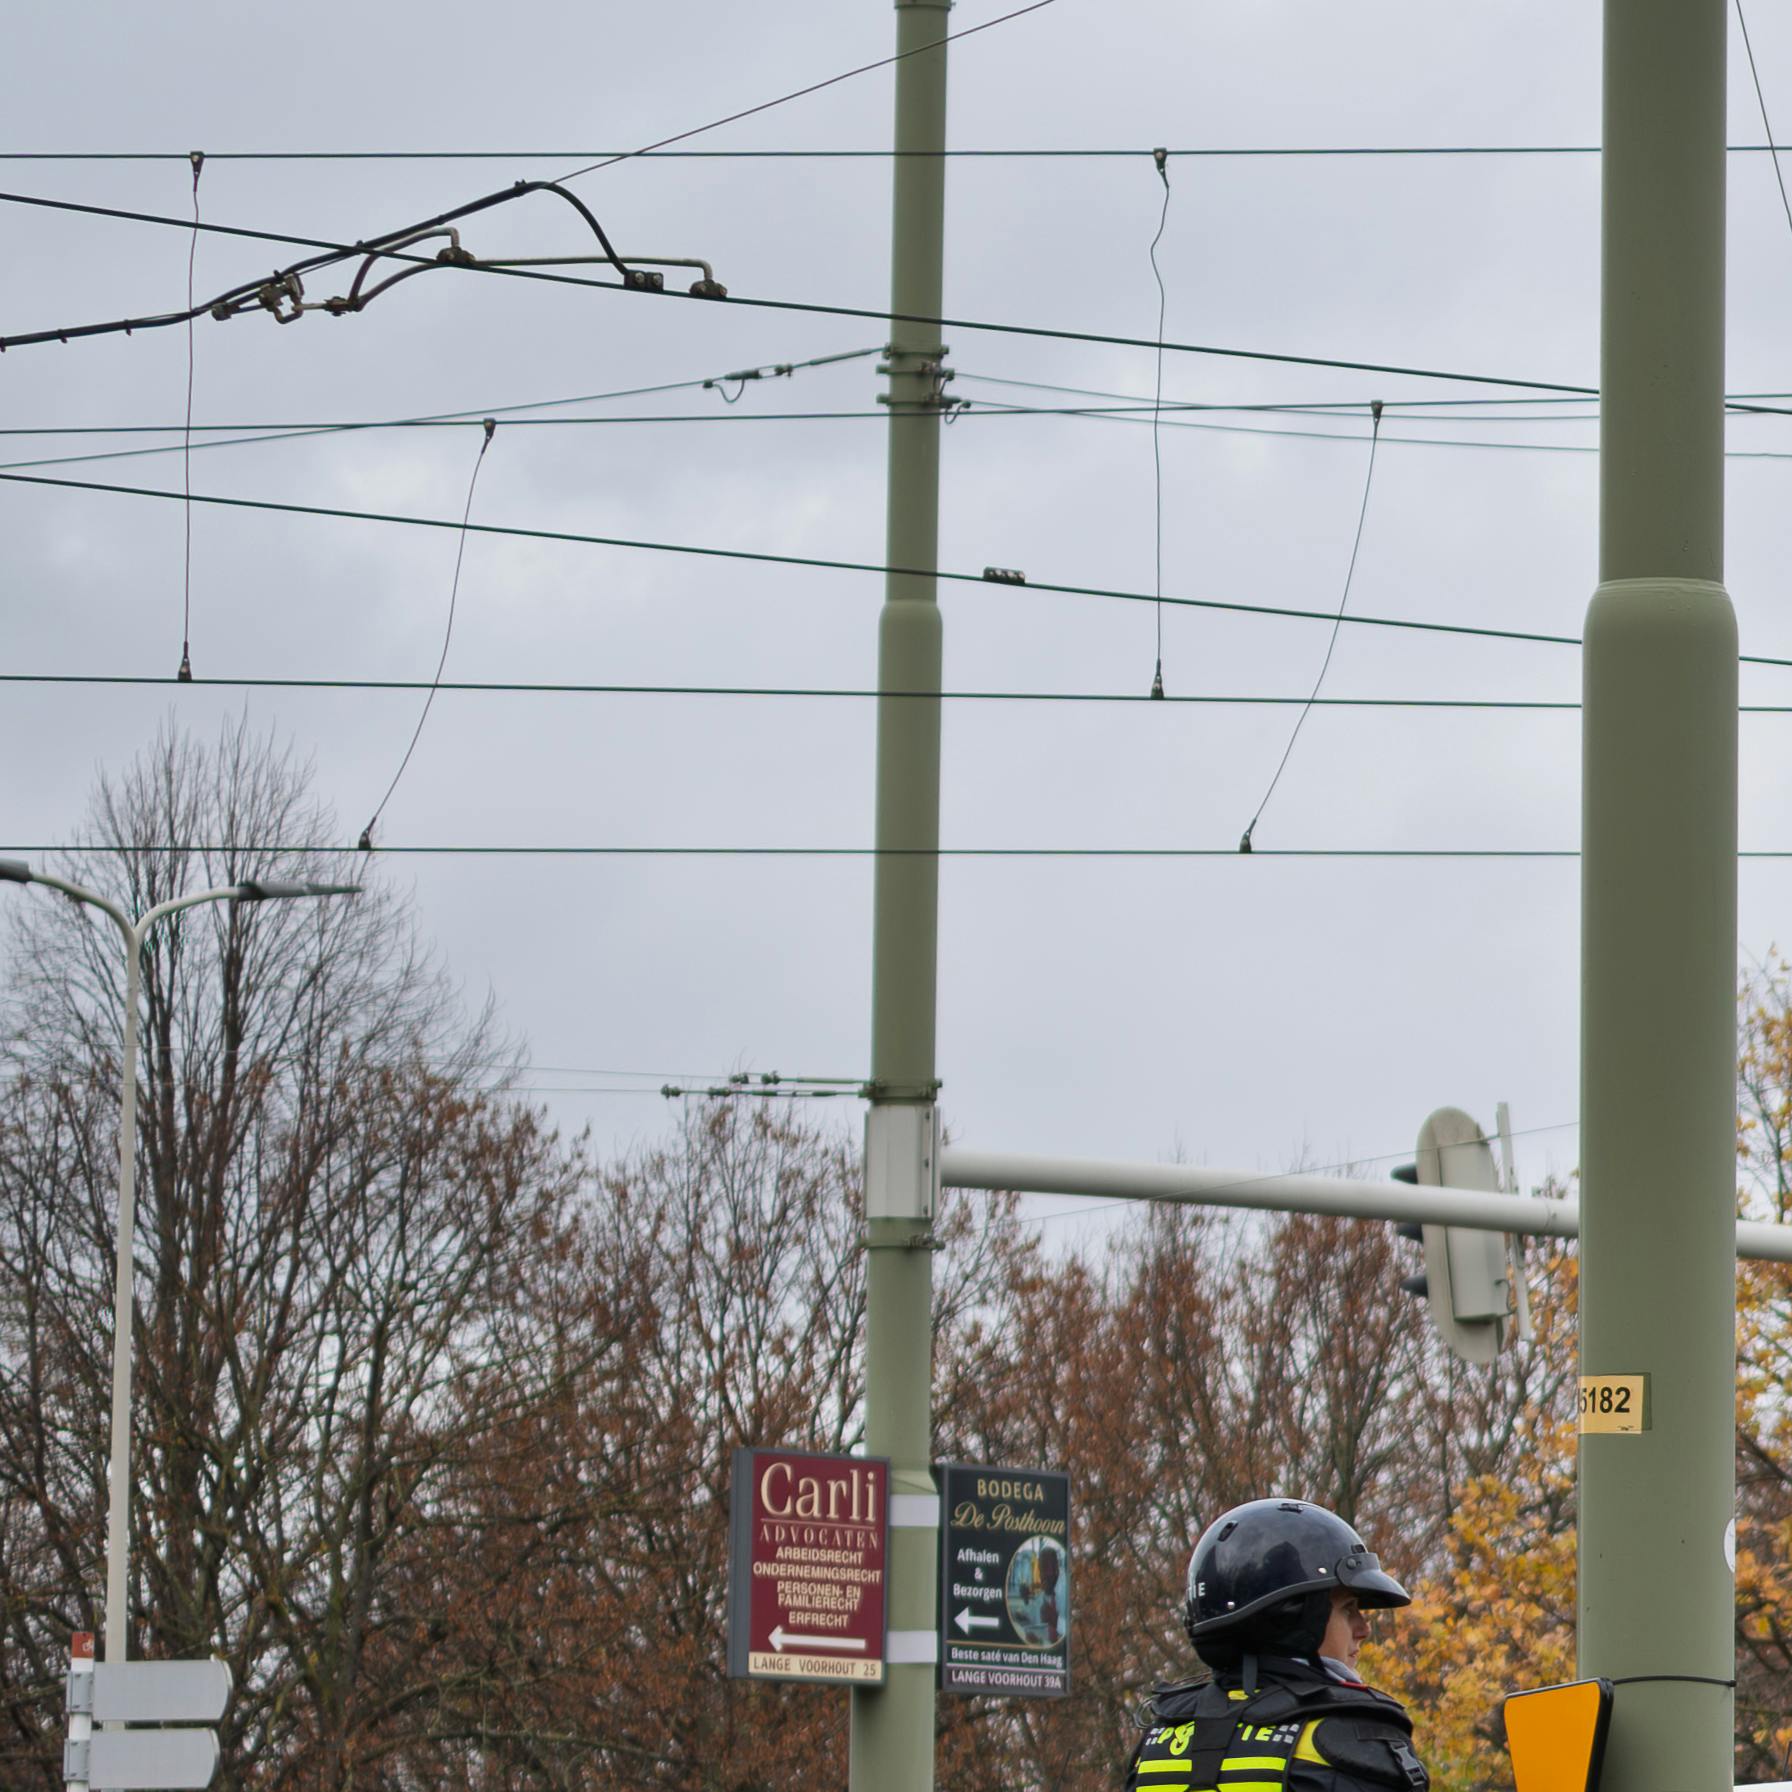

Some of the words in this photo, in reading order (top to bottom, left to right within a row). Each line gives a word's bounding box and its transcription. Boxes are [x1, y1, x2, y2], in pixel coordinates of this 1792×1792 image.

[760, 1462, 877, 1521] Carli
[977, 1479, 1044, 1502] BODEGA
[950, 1501, 985, 1529] De
[986, 1503, 1065, 1534] Posthoorn
[760, 1524, 879, 1550] ADVOCATEN
[776, 1546, 864, 1564] ARBEIDSRECHT
[957, 1547, 999, 1564] Afhalen
[753, 1561, 882, 1583] ONDERNEMINGSRECHT
[974, 1567, 983, 1580] &
[777, 1581, 844, 1597] PERSONEN-
[846, 1585, 861, 1598] EN
[953, 1583, 1002, 1603] Bezorgen
[778, 1593, 860, 1611] FAMILIERECHT
[788, 1611, 849, 1628] ERFRECHT
[753, 1657, 791, 1672] LANGE
[799, 1659, 856, 1674] VOORHOUT
[864, 1664, 876, 1676] 25
[951, 1647, 980, 1660] Beste
[981, 1649, 1001, 1663] saté
[1003, 1654, 1019, 1664] van
[1021, 1652, 1039, 1664] Den
[1040, 1653, 1063, 1668] Haag
[951, 1670, 985, 1684] LANGE
[988, 1672, 1042, 1687] VOORHOUT
[1043, 1676, 1062, 1688] 39A
